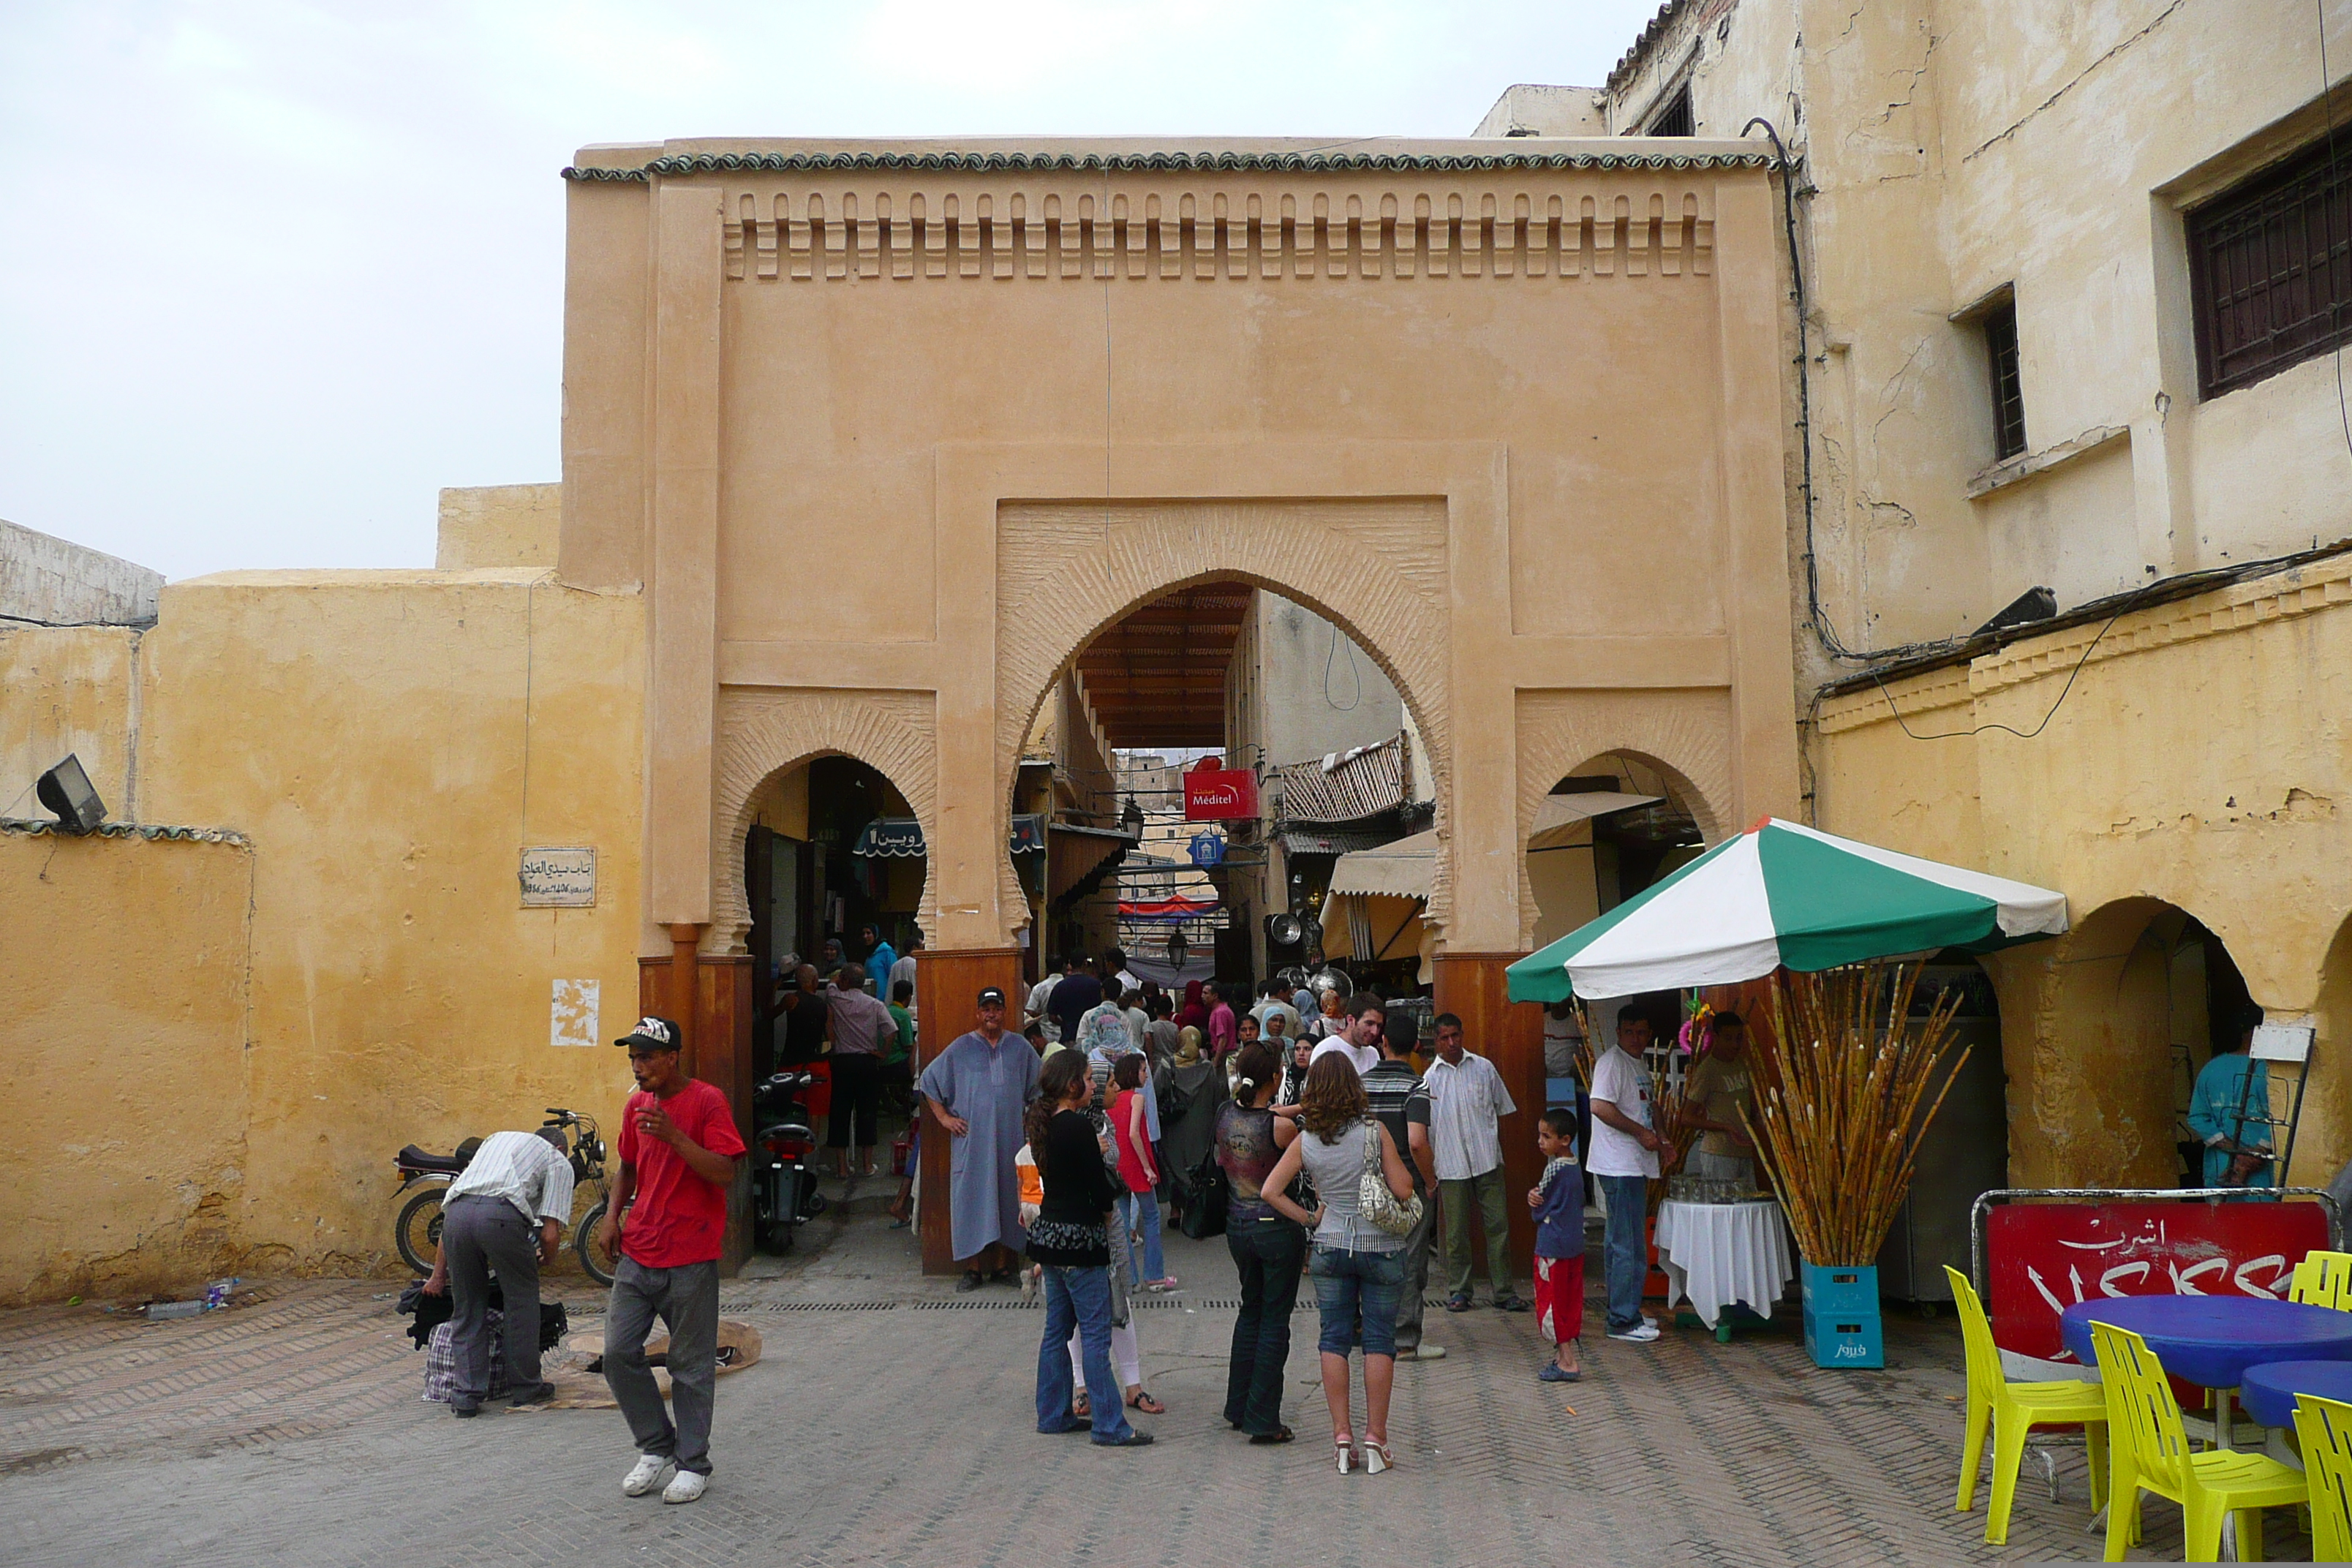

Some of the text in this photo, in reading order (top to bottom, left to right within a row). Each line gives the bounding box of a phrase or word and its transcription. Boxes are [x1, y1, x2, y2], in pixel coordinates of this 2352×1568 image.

[1193, 794, 1232, 805] Méditel
[526, 883, 542, 893] 986
[1834, 1344, 1866, 1358] فيروز
